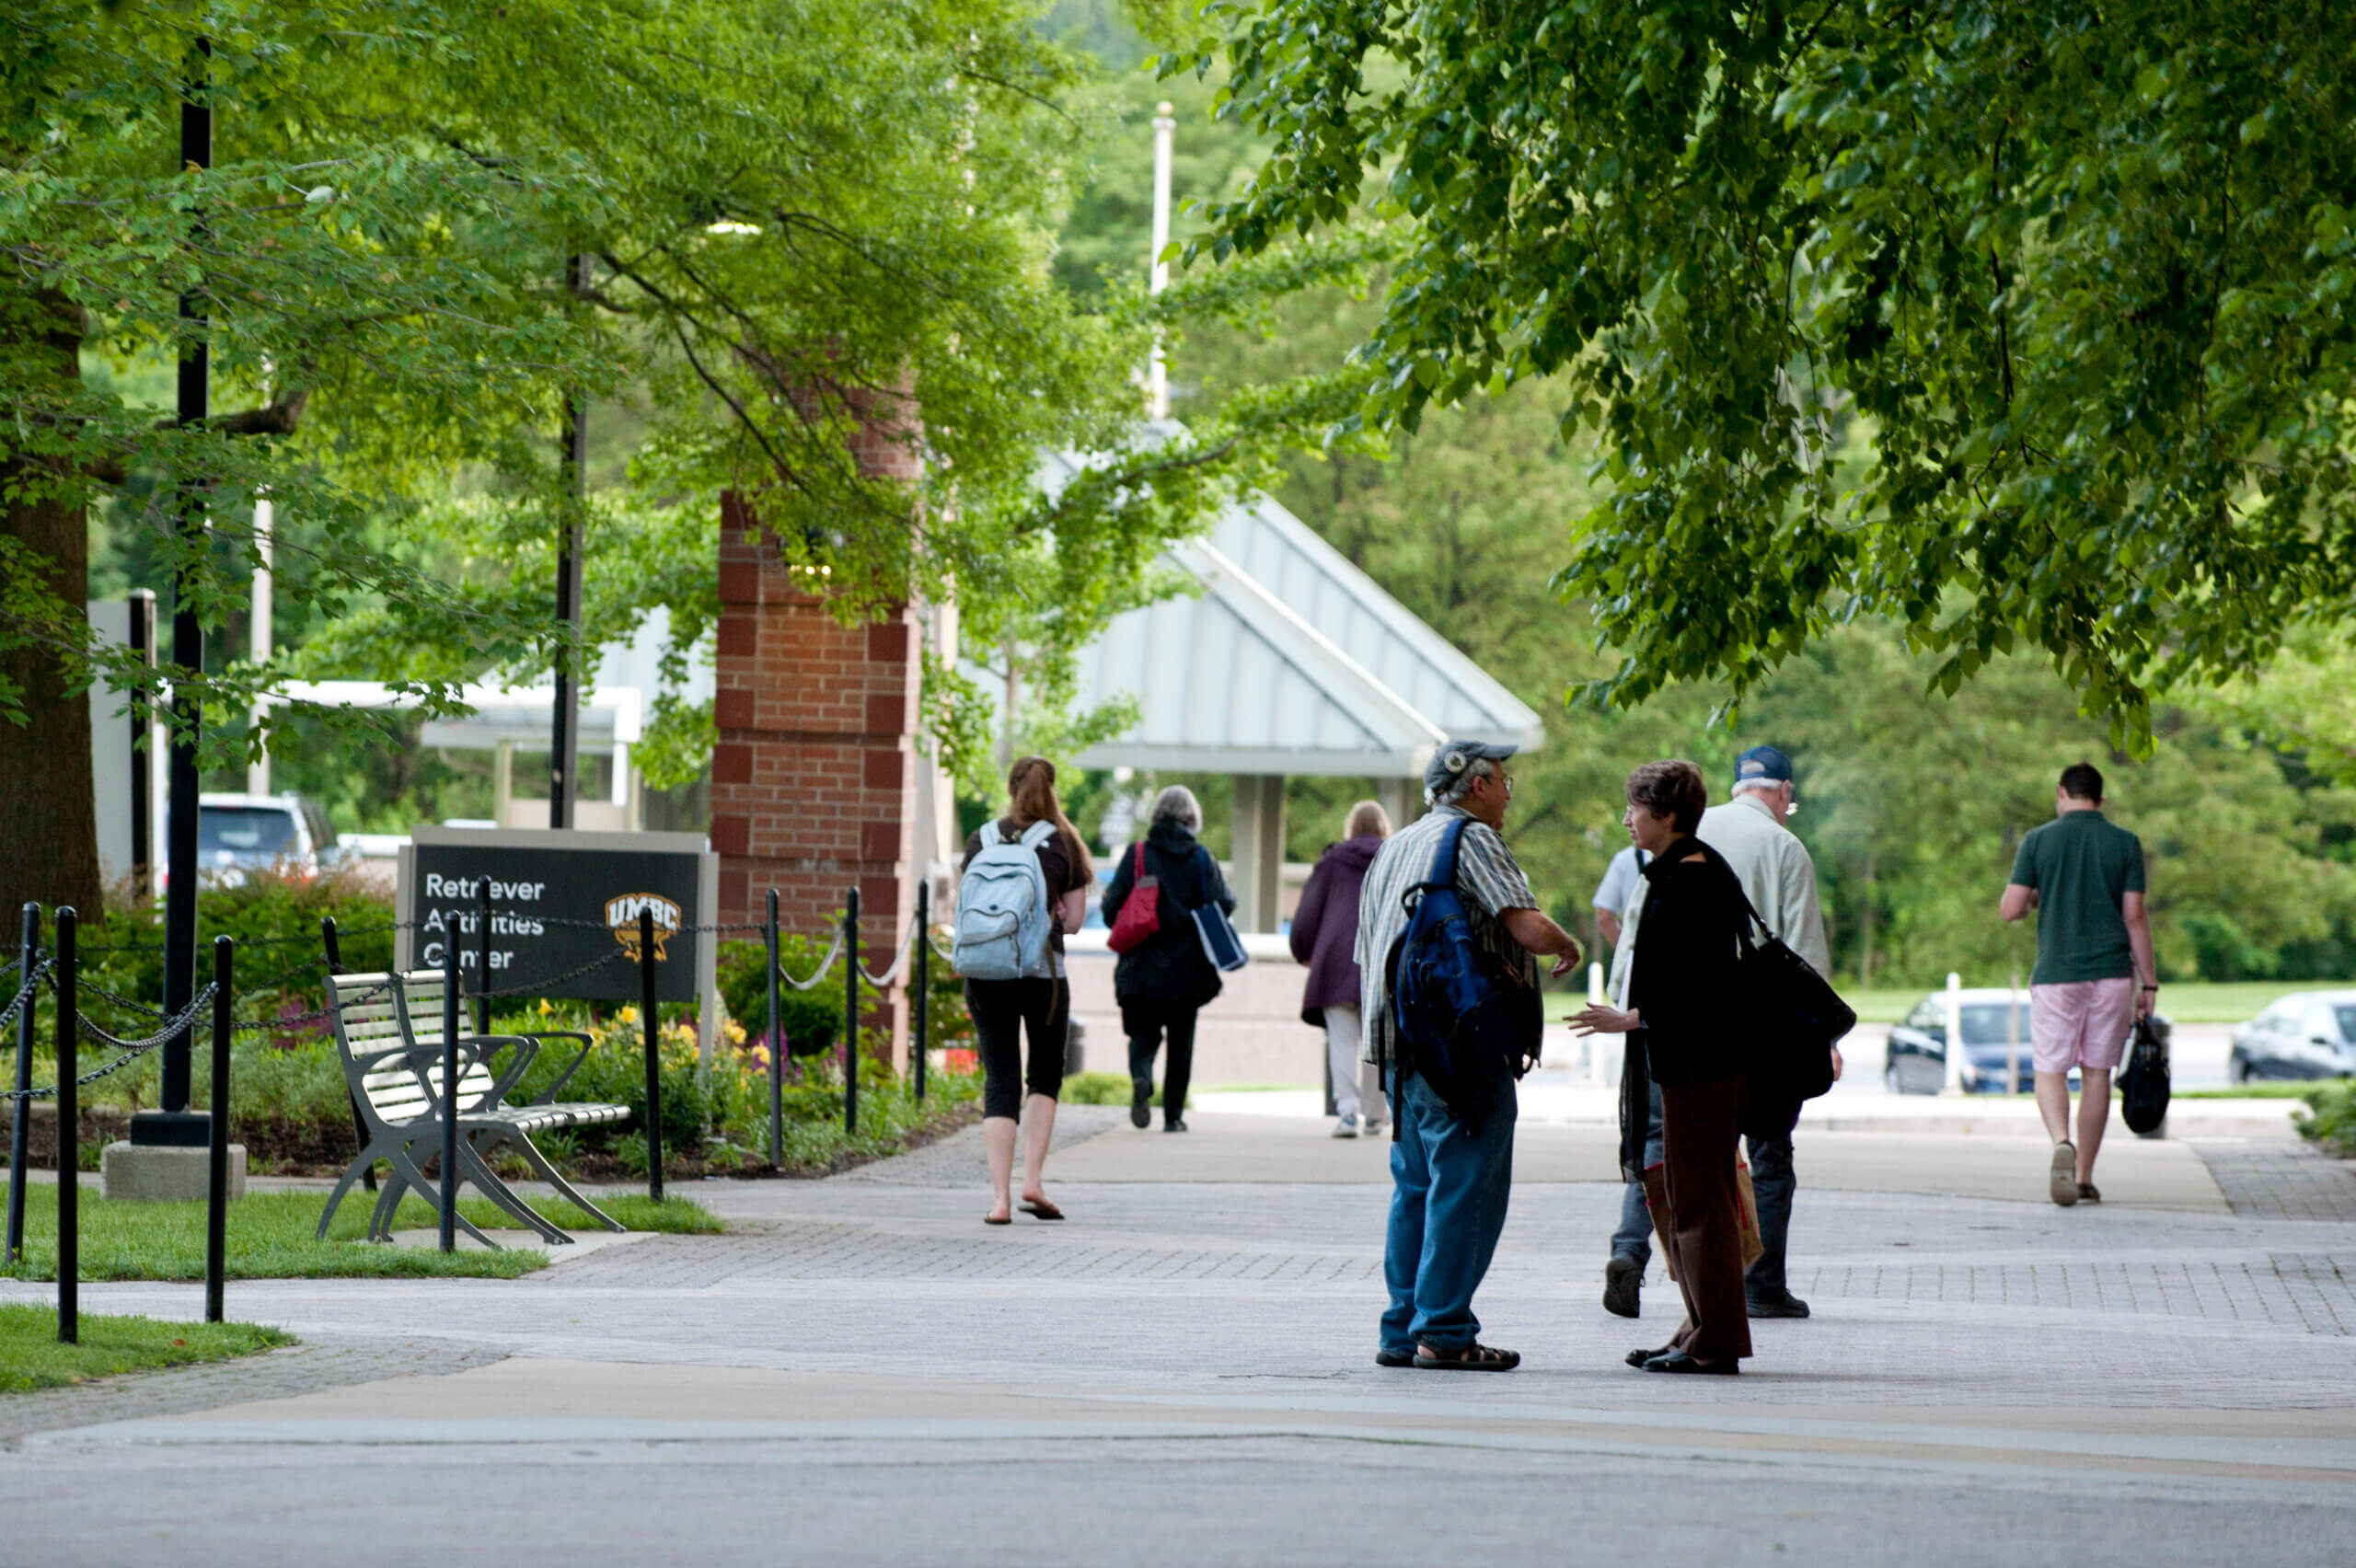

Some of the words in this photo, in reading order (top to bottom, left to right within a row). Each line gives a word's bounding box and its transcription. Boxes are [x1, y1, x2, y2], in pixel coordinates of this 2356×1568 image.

[426, 873, 545, 900] Retrever
[423, 907, 545, 935] Atiities
[423, 942, 514, 969] Cner
